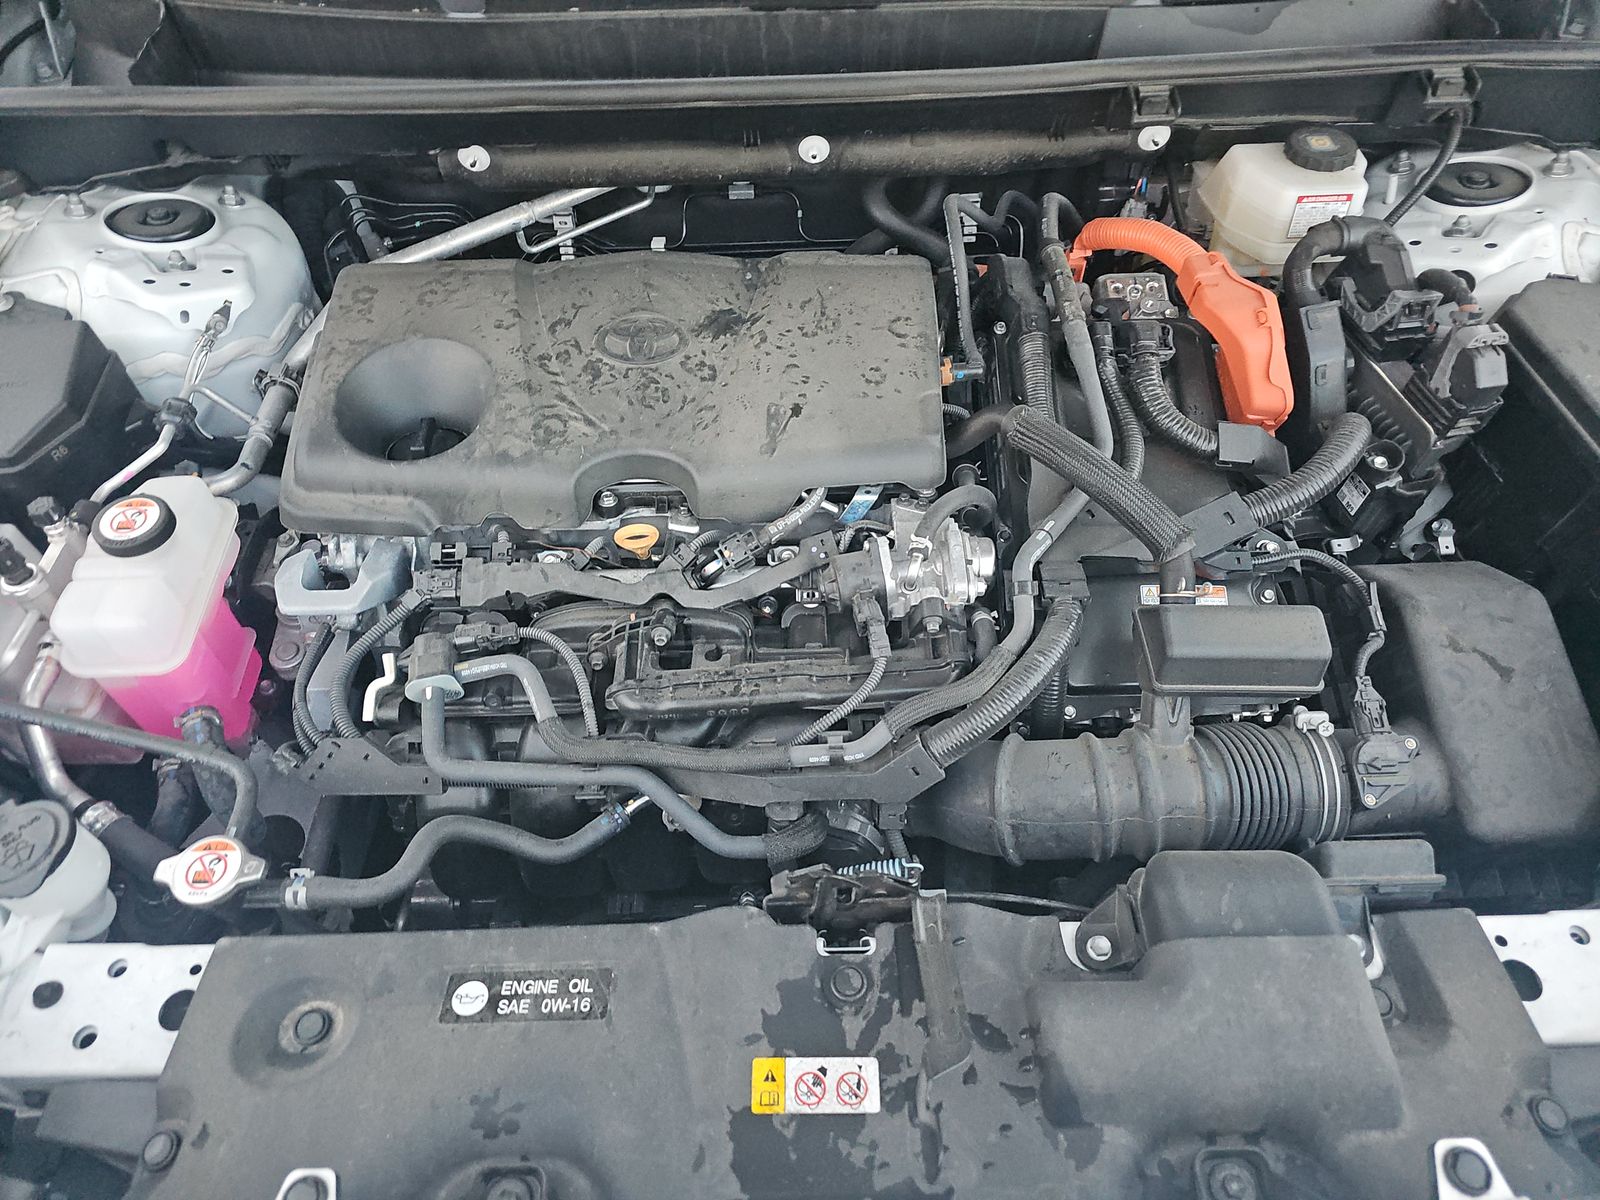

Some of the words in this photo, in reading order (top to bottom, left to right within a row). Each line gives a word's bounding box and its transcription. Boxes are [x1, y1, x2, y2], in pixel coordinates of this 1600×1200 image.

[501, 979, 559, 995] ENGINE
[568, 978, 594, 993] OIL
[497, 999, 530, 1014] SAE
[541, 997, 591, 1013] 0W-16
